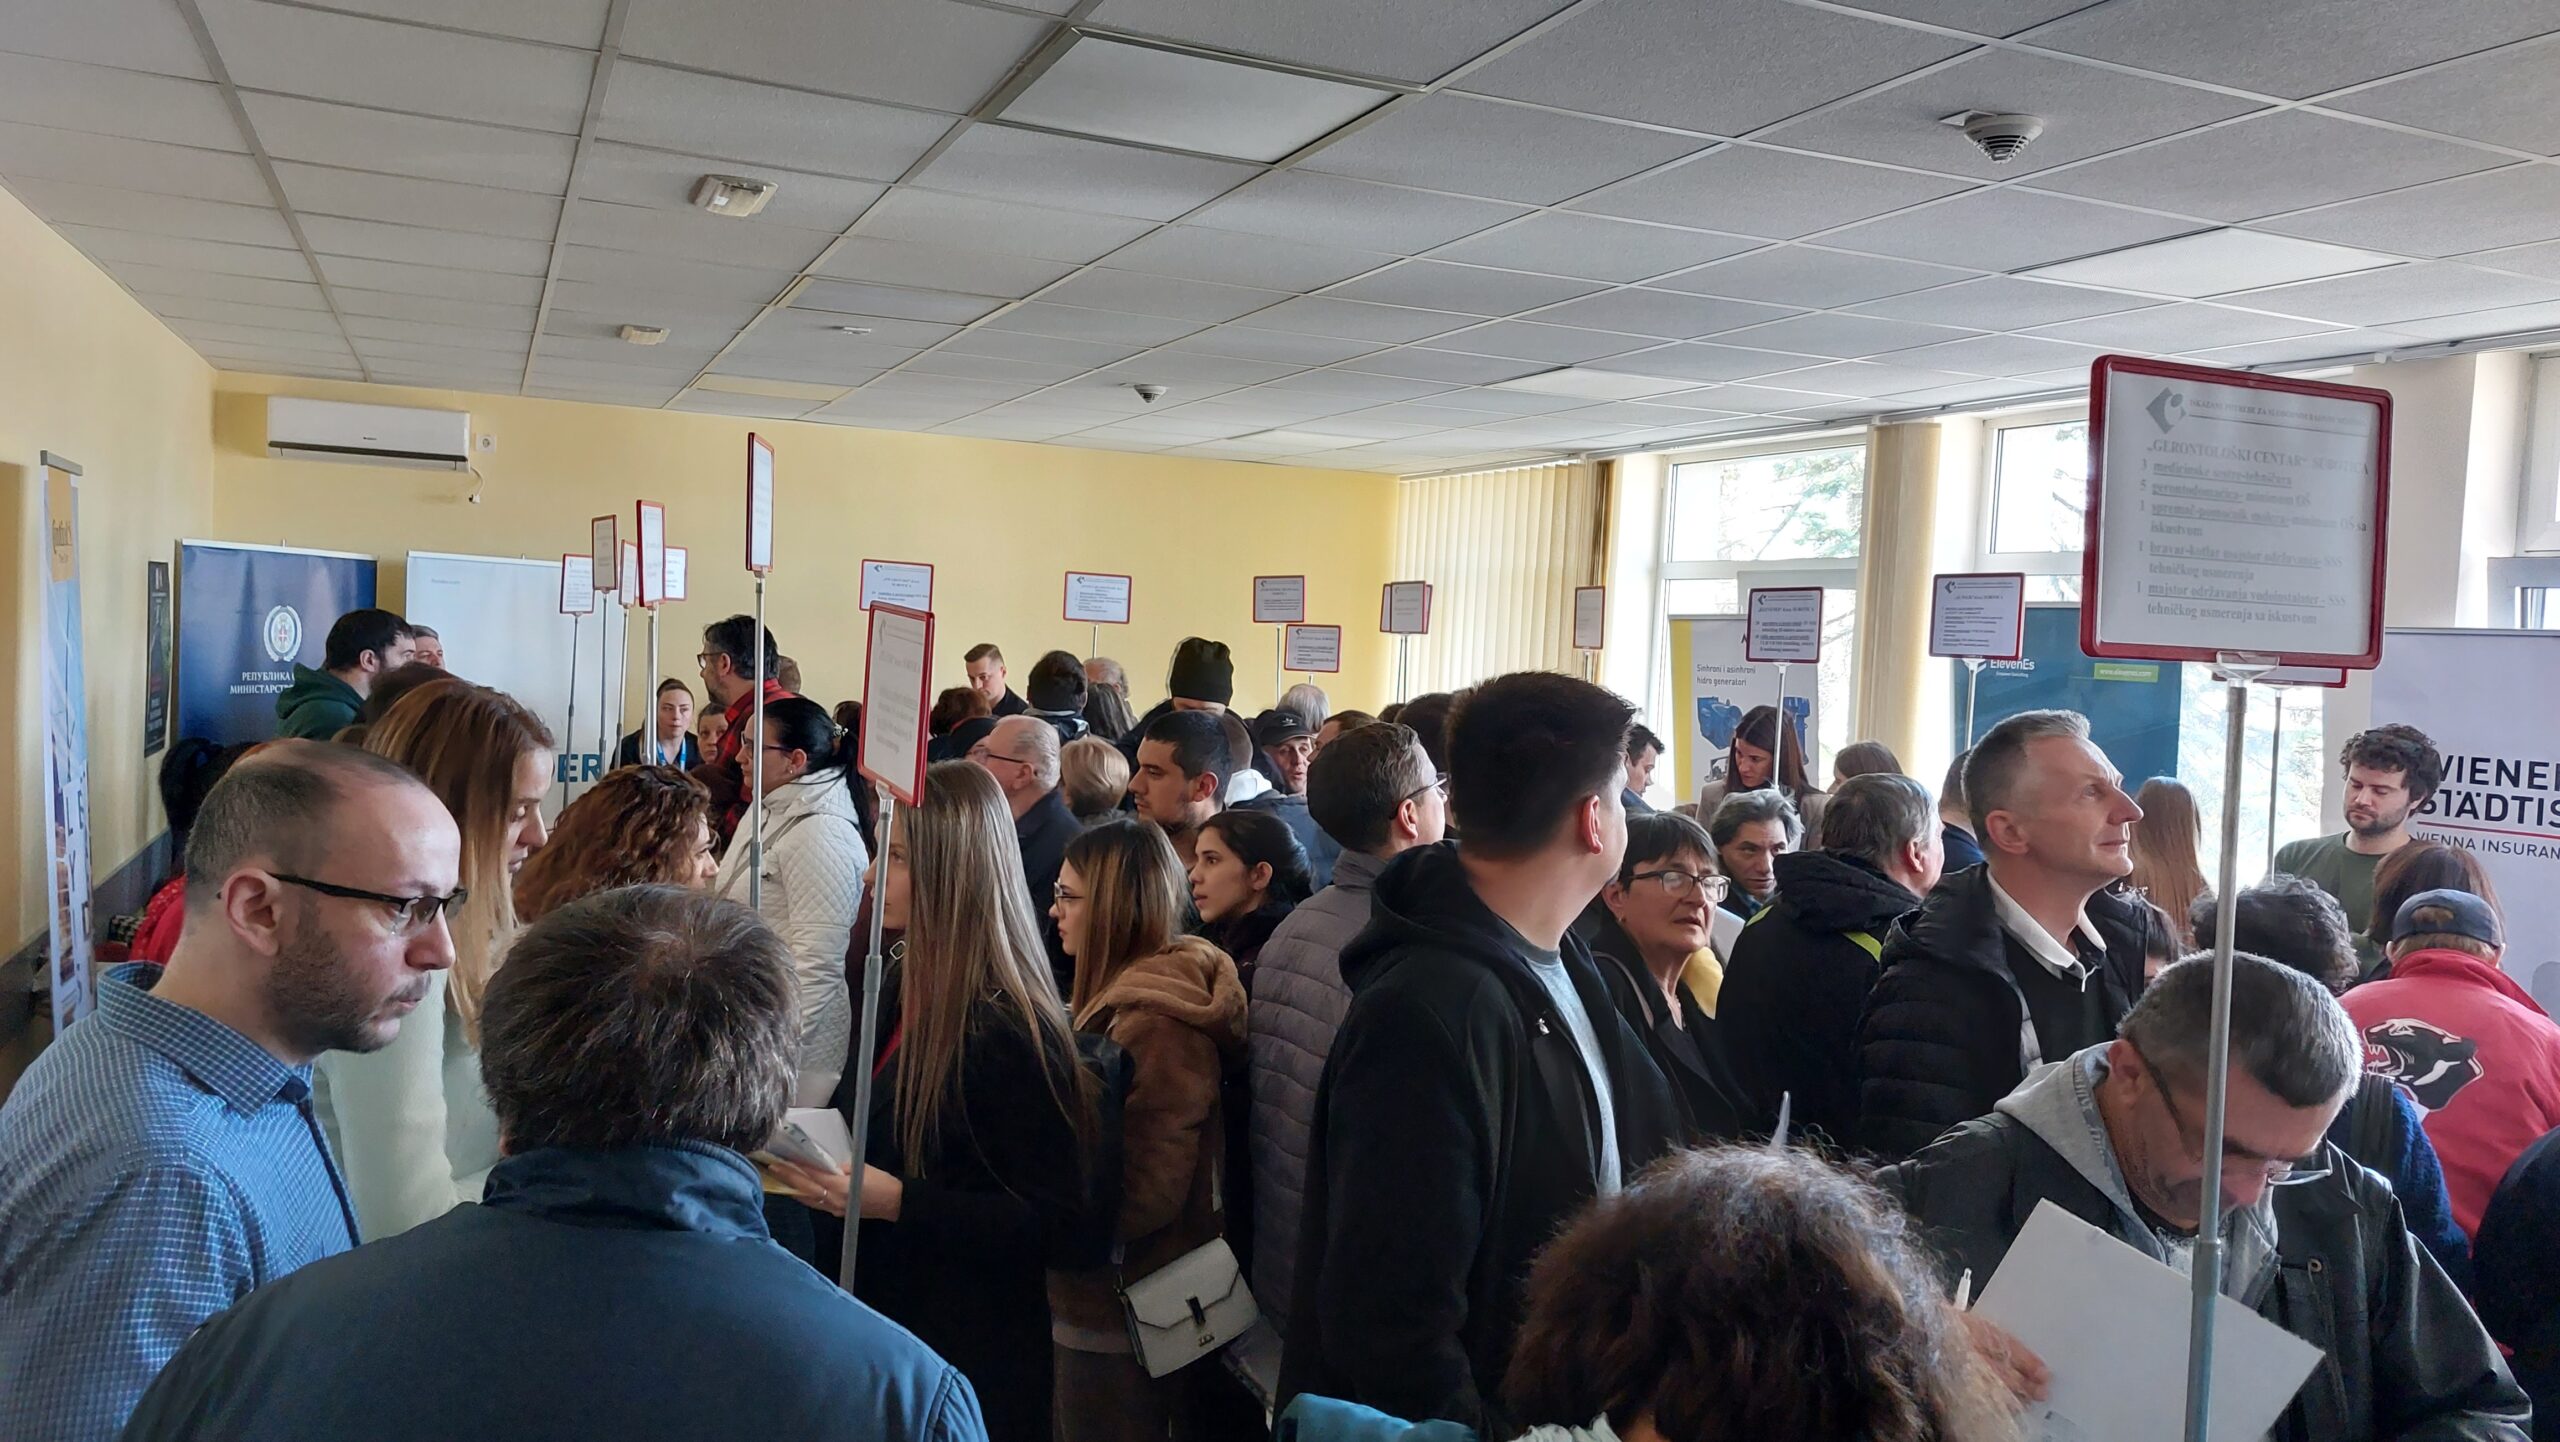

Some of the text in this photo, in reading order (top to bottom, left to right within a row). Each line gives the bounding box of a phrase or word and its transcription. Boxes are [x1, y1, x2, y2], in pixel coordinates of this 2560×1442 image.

[2141, 478, 2146, 491] 5
[2150, 520, 2203, 536] iskustvom
[2149, 560, 2254, 584] tehničkog usmerenja
[2148, 581, 2187, 597] majstor
[2192, 584, 2247, 601] održavanja
[2147, 601, 2316, 624] tehničkog usmerenja sa iskustvom
[1696, 664, 1722, 673] Sinhroni
[1726, 665, 1756, 674] asinhroni
[242, 671, 291, 681] РЕПУБЛИКА
[1696, 677, 1747, 687] hidro generatori
[230, 684, 295, 694] МИНИСТАРСТ
